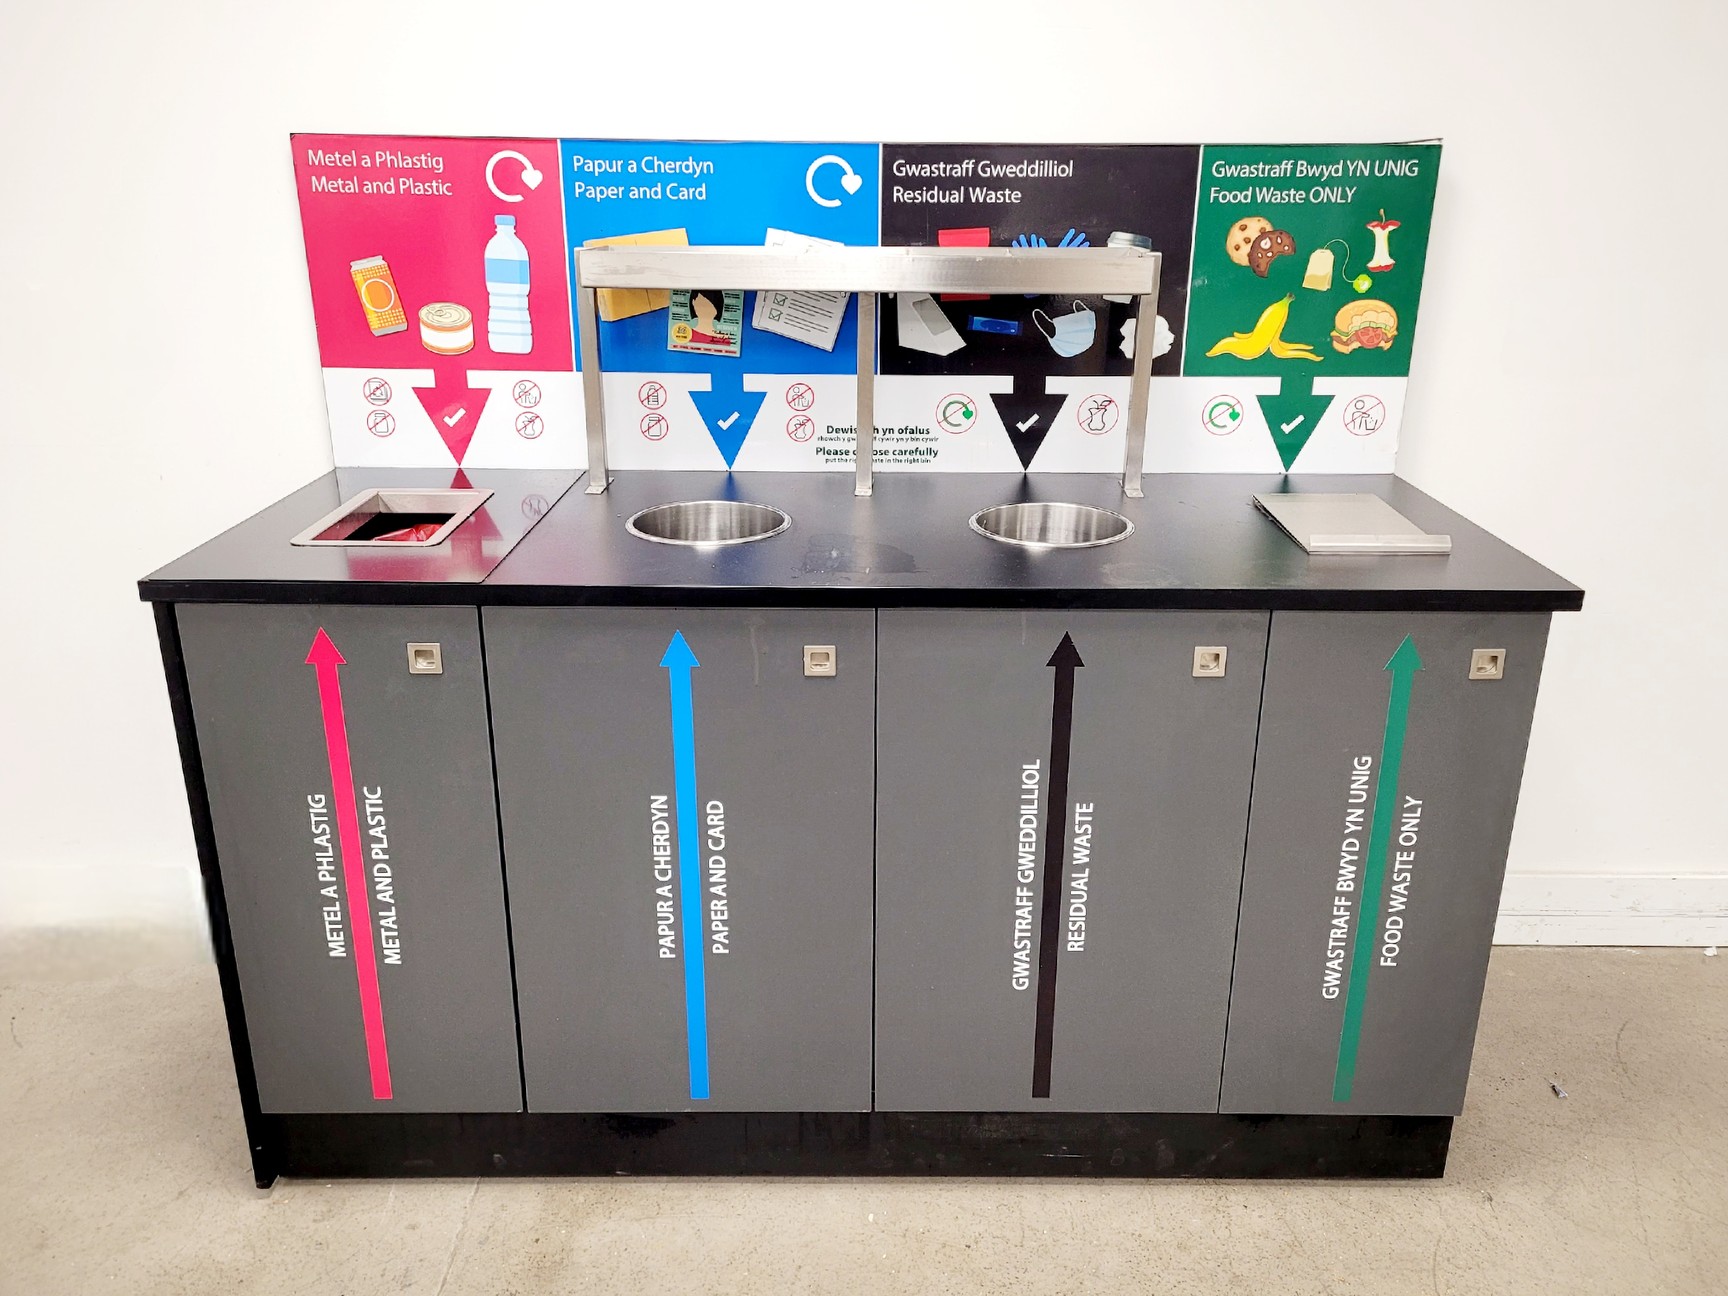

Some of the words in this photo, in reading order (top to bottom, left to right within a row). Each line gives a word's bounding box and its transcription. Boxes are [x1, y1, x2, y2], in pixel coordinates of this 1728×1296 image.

[307, 149, 357, 167] Metel
[361, 155, 371, 168] a
[375, 151, 444, 173] Phlastig
[311, 176, 359, 193] Metal
[363, 177, 395, 194] and
[399, 178, 453, 195] Plastic
[573, 155, 623, 177] Papur
[627, 160, 637, 173] a
[641, 156, 714, 178] Cherdyn
[893, 159, 976, 177] Gwastraff
[977, 160, 1074, 177] Gweddilliol
[1212, 160, 1295, 178] Gwastraff
[1296, 160, 1344, 181] Bwyd
[1347, 160, 1371, 177] YN
[1374, 159, 1419, 177] UNIG
[574, 181, 624, 202] Paper
[629, 183, 662, 199] and
[666, 183, 707, 200] Card
[893, 186, 964, 203] Residual
[969, 187, 1022, 203] Waste
[1210, 187, 1252, 204] Food
[1255, 187, 1306, 204] Waste
[1309, 186, 1357, 204] ONLY
[815, 447, 850, 456] Please
[892, 447, 938, 458] carefully
[826, 425, 879, 435] Dewish
[882, 427, 895, 436] yn
[898, 425, 930, 435] ofalus
[1348, 756, 1372, 804] UNIG
[307, 794, 337, 882] PHLASTIG
[363, 786, 390, 860] PLASTIC
[650, 795, 672, 882] CHERDYN
[706, 800, 725, 851] CARD
[1017, 759, 1040, 884] GWEDDILLIOL
[1073, 802, 1094, 865] WASTE
[1344, 809, 1365, 835] YN
[1398, 795, 1423, 847] ONLY
[373, 863, 395, 904] AND
[708, 855, 727, 897] AND
[1336, 837, 1360, 892] BWYD
[1388, 851, 1415, 913] WASTE
[320, 885, 339, 899] A
[656, 884, 673, 898] A
[1067, 868, 1089, 952] RESIDUAL
[323, 901, 347, 957] METEL
[378, 906, 402, 965] METAL
[656, 900, 676, 958] PAPUR
[711, 899, 729, 954] PAPER
[1012, 886, 1034, 991] GWASTRAFF
[1322, 896, 1352, 1000] GWASTRAFF
[1380, 916, 1404, 967] FOOD
